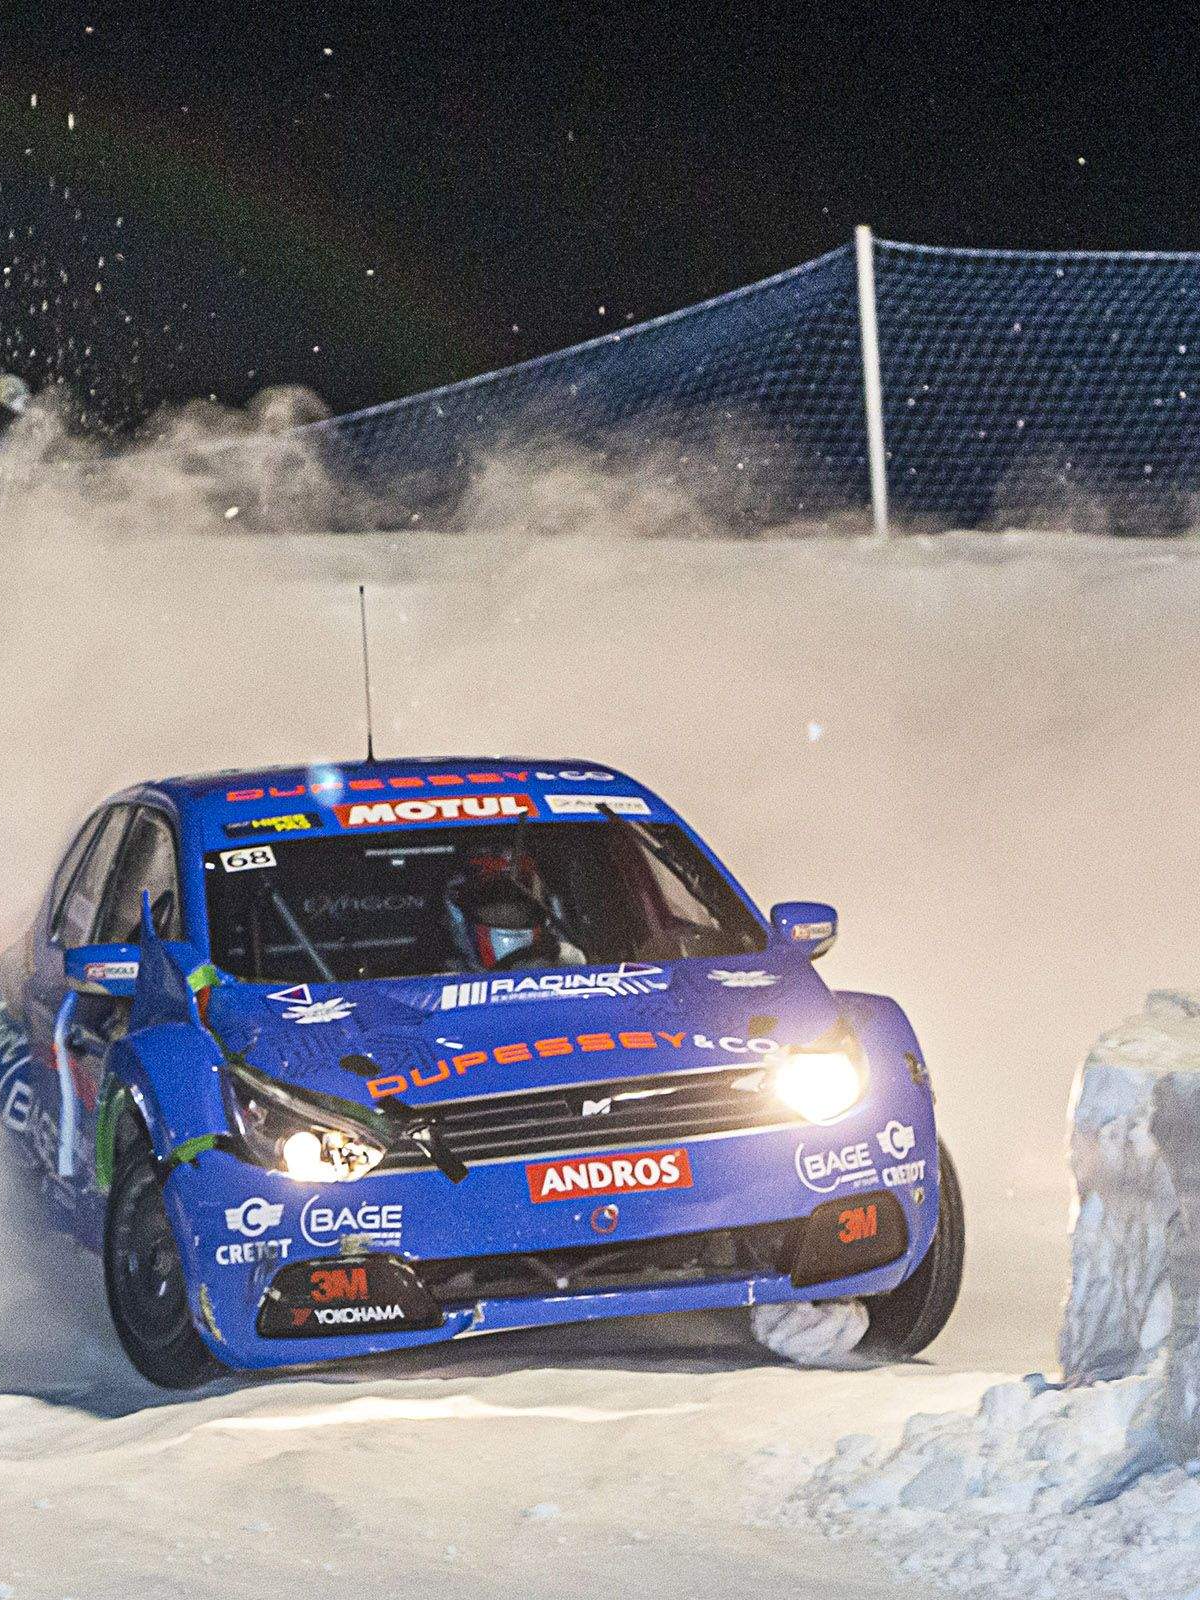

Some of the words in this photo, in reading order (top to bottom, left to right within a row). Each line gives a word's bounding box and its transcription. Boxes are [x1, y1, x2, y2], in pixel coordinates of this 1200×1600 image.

[348, 795, 528, 825] MOTUL
[227, 848, 271, 869] 68
[490, 972, 620, 994] RACING
[541, 1154, 681, 1197] ANDROS
[803, 1143, 874, 1181] BAGE
[310, 1204, 403, 1233] BAGE
[838, 1203, 878, 1244] 3M
[310, 1267, 368, 1303] 3M
[313, 1304, 405, 1325] YOKOHAMA
